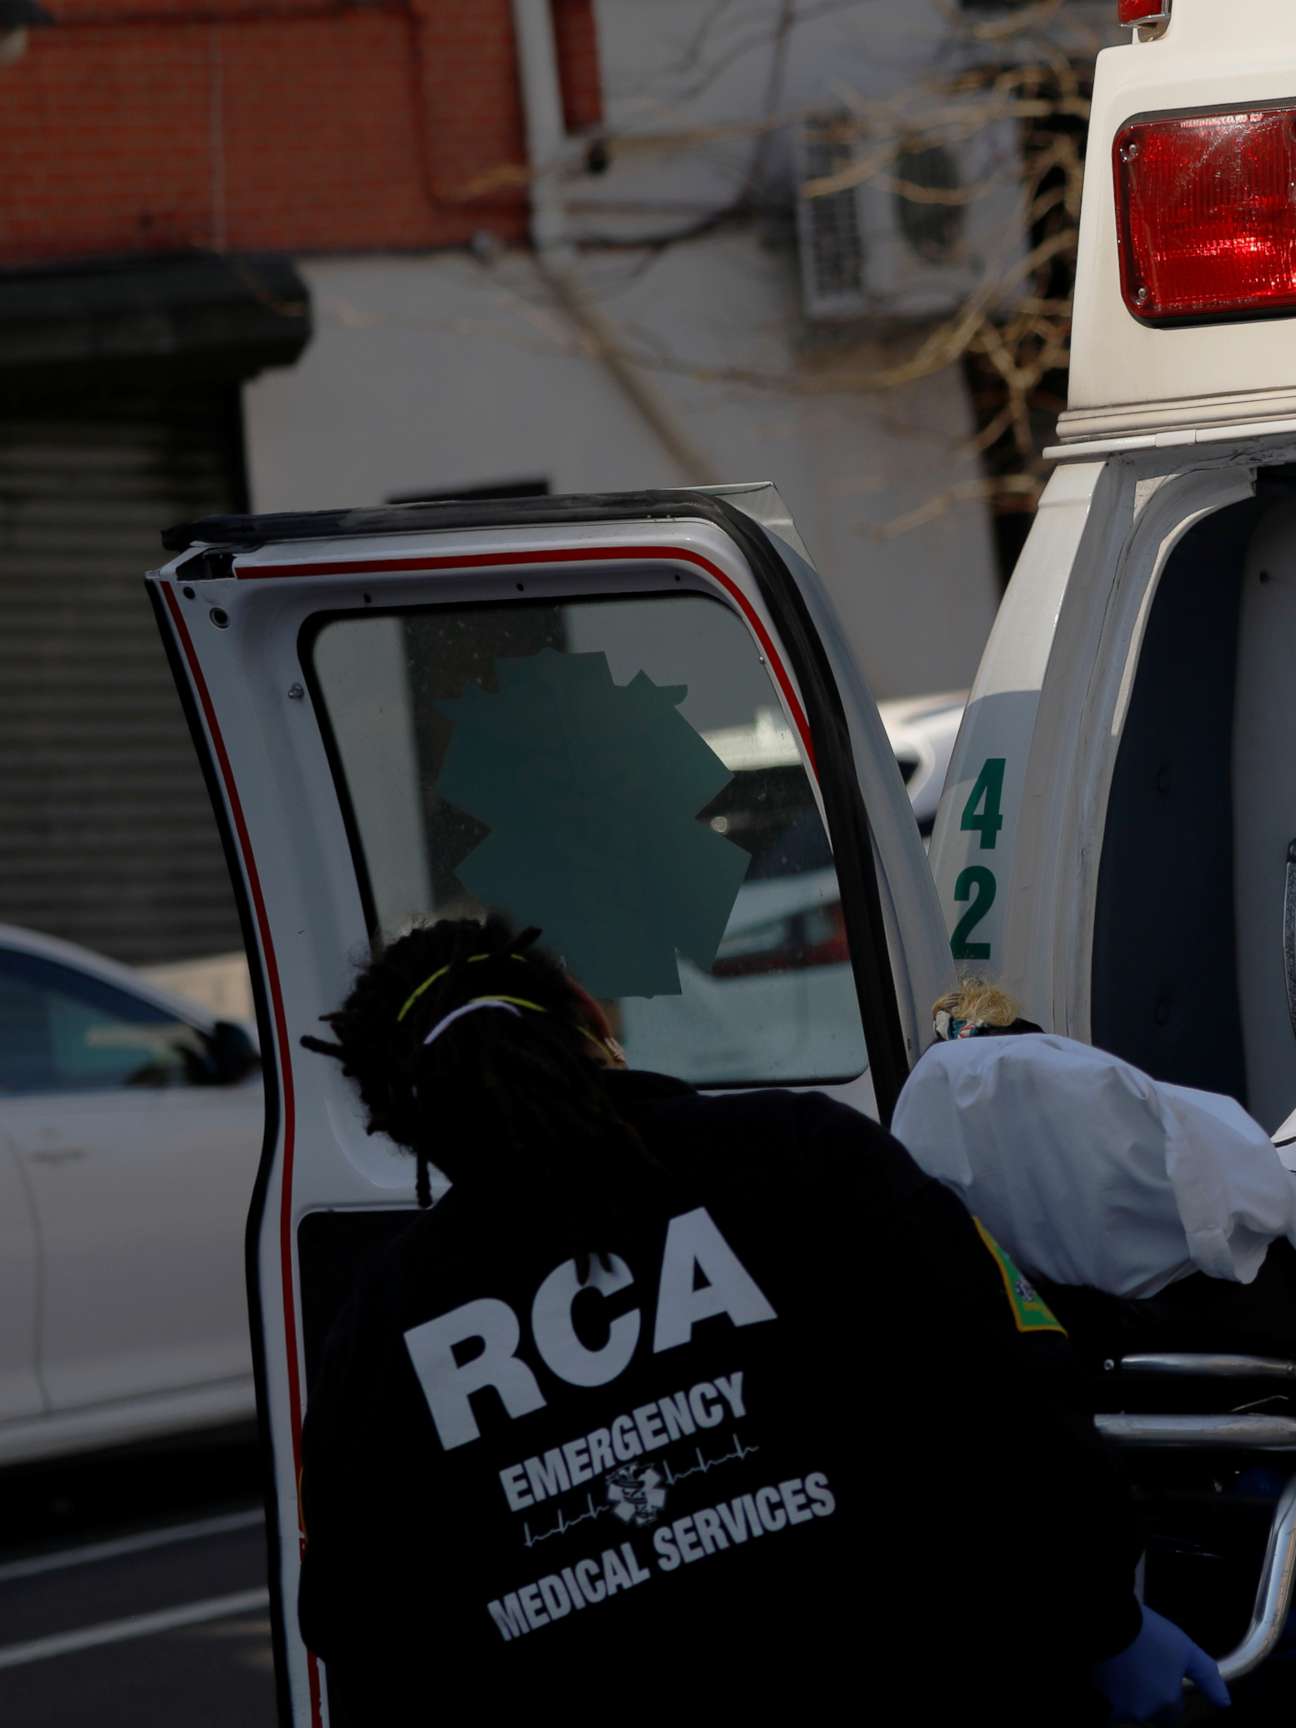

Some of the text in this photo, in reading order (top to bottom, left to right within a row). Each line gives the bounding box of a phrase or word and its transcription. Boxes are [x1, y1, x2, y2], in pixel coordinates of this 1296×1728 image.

[403, 1205, 779, 1451] RCA
[498, 1370, 748, 1513] EMERGENCY
[486, 1471, 837, 1642] MEDICAL SERVICES
